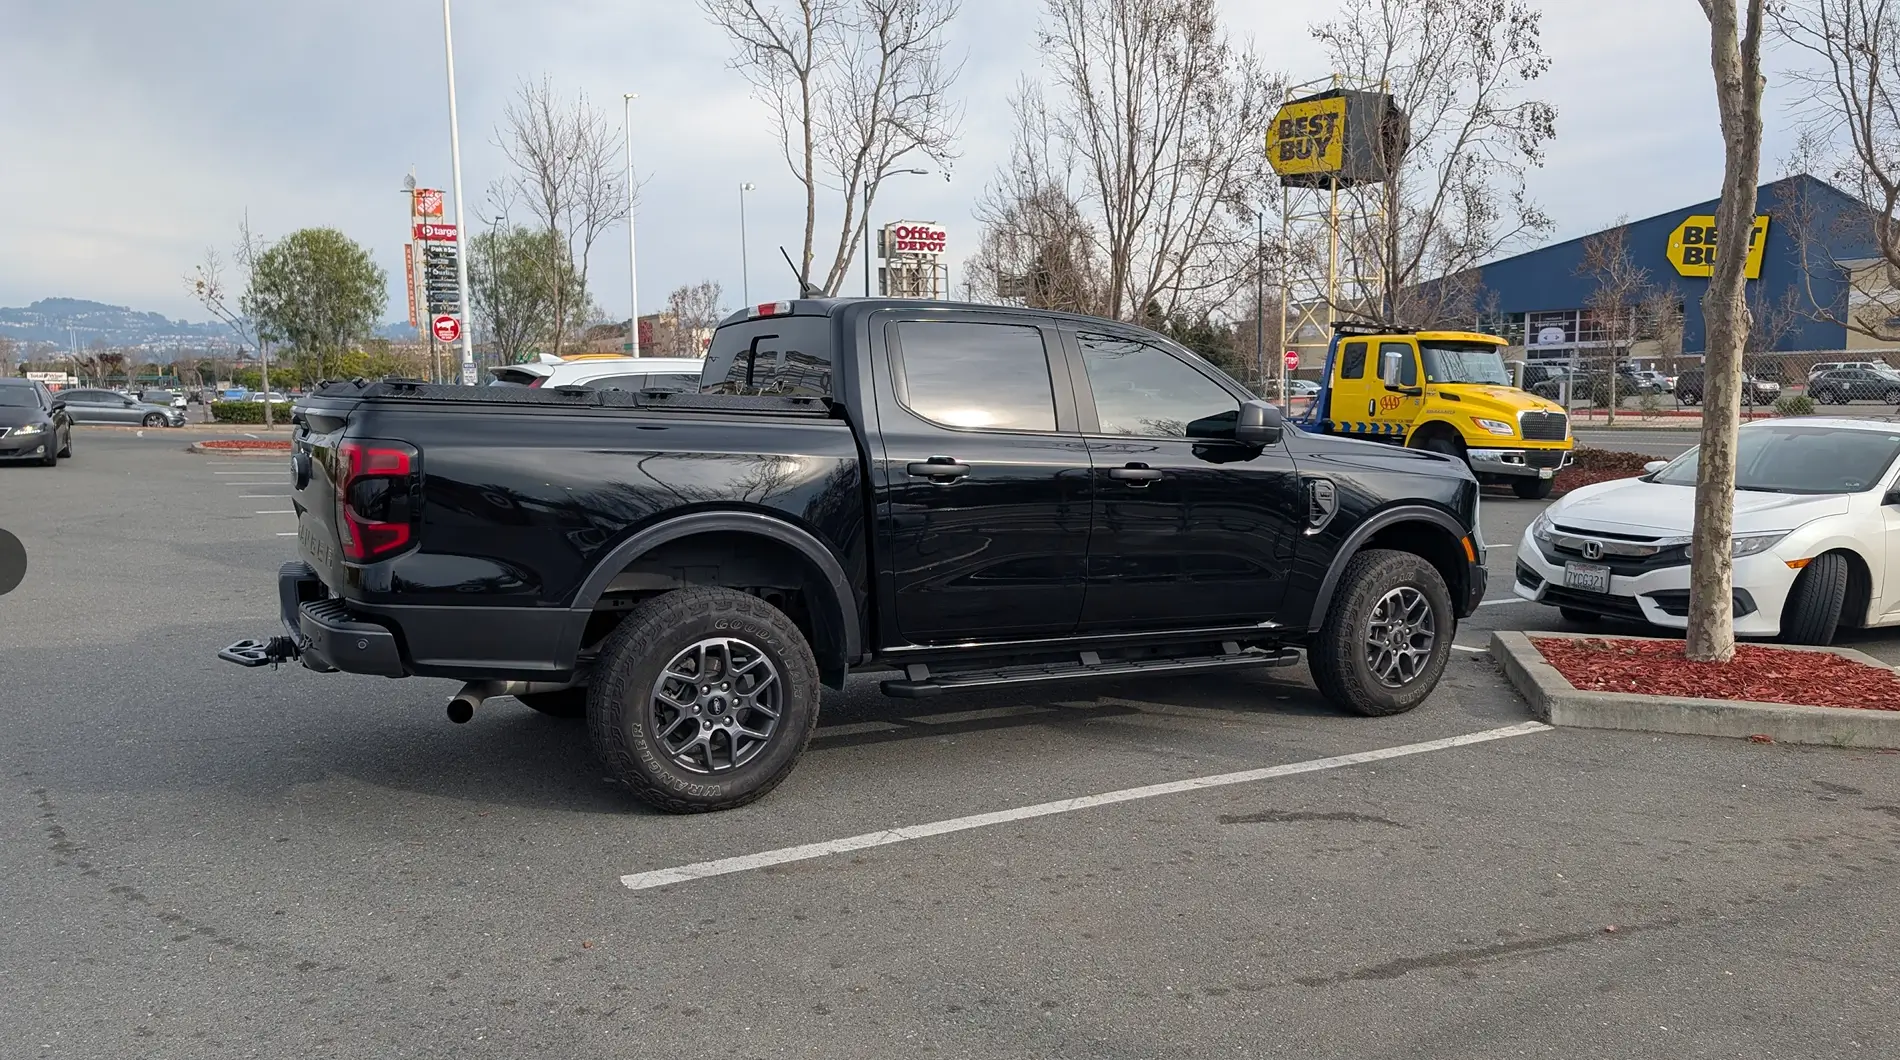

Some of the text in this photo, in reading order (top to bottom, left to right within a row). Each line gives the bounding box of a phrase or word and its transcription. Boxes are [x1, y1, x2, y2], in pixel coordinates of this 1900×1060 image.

[1279, 112, 1339, 140] BEST
[1280, 135, 1333, 161] BUY
[434, 227, 457, 237] targe
[896, 226, 946, 241] Office
[1682, 226, 1762, 246] BET
[897, 241, 946, 252] DEPOT
[1285, 356, 1299, 365] STOP
[714, 618, 803, 699] GOODYEAR
[631, 723, 722, 797] WRANGLER
